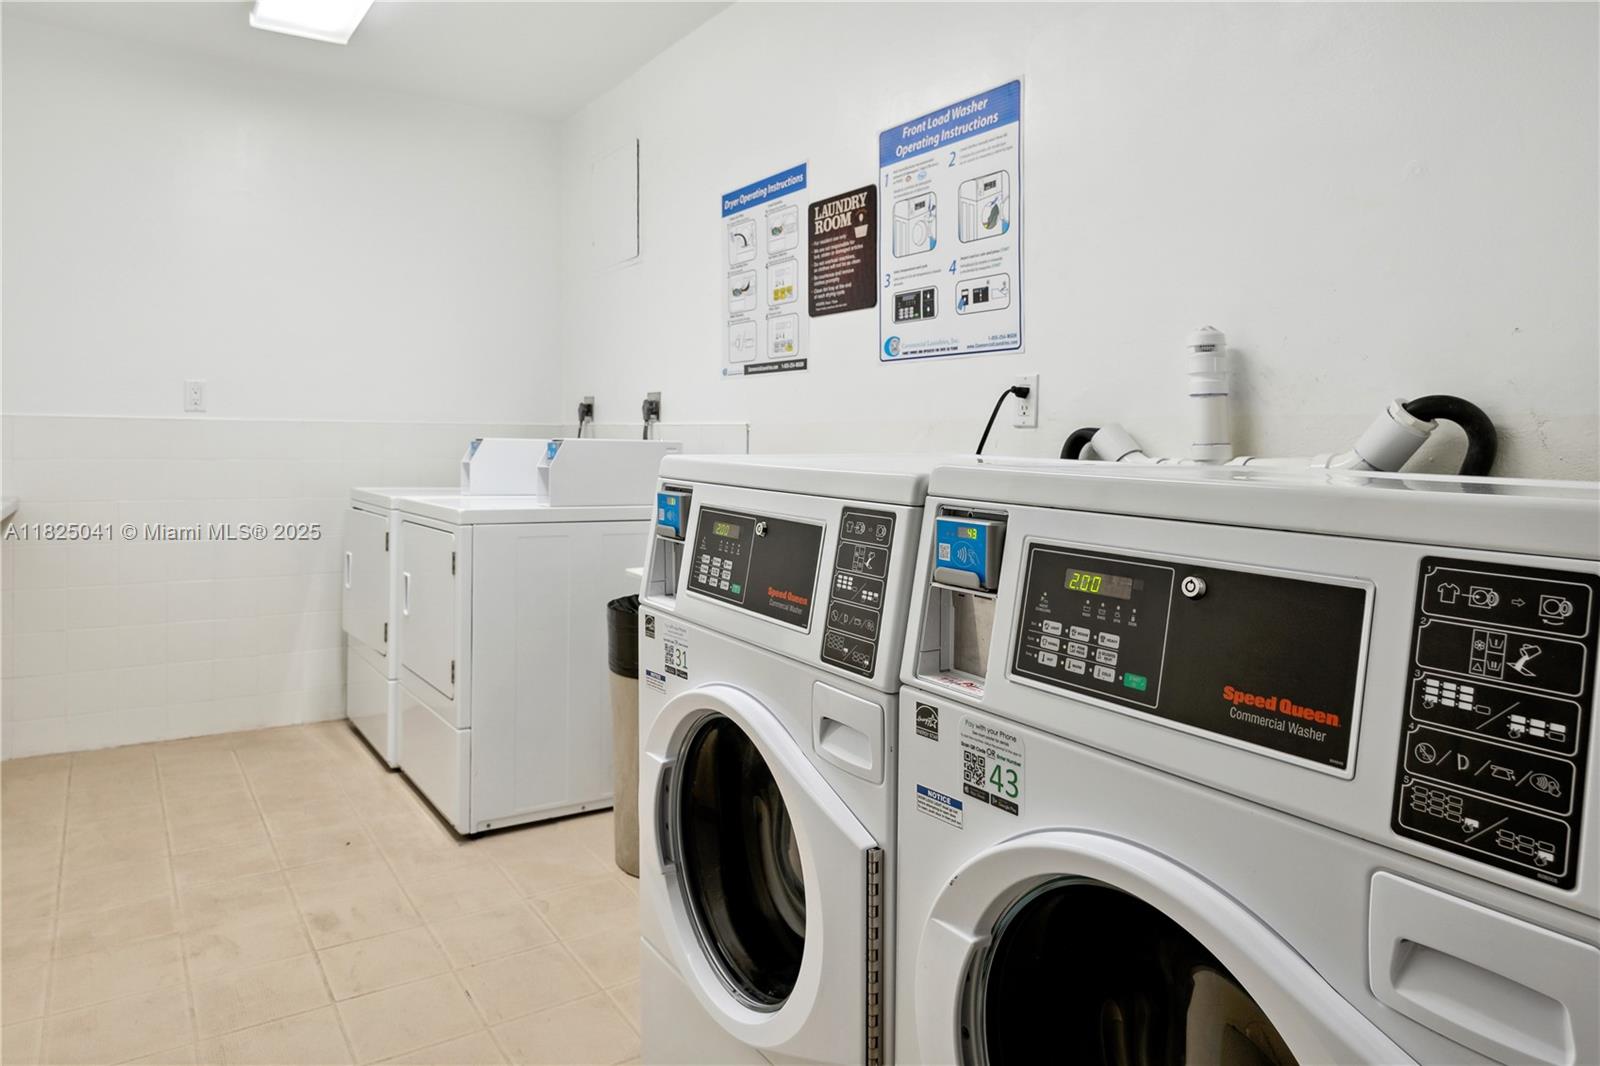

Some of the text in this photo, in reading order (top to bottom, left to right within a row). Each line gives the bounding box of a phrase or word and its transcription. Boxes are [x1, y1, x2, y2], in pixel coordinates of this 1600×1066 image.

[902, 98, 988, 138] Front Load Washer
[896, 134, 940, 158] Operating
[941, 112, 999, 140] Instructions
[948, 151, 956, 168] 2
[885, 174, 889, 188] 1
[724, 174, 804, 210] Dryer Operating Instructions
[814, 192, 868, 220] LAUNDRY
[814, 212, 852, 235] ROOM
[948, 260, 957, 275] 4
[884, 274, 890, 288] 3
[966, 528, 978, 540] 43
[1068, 572, 1102, 592] 2.00
[768, 586, 808, 605] Speed Queen
[676, 648, 688, 670] 31
[1414, 669, 1420, 677] 3
[1223, 685, 1340, 726] Speed Queen
[964, 719, 974, 729] Pay
[976, 724, 986, 733] with
[987, 728, 998, 736] your
[1000, 730, 1017, 742] Phone
[1229, 706, 1328, 742] Commercial Washer
[986, 748, 996, 758] OR
[990, 764, 1018, 798] 43
[927, 790, 952, 804] NOTICE
